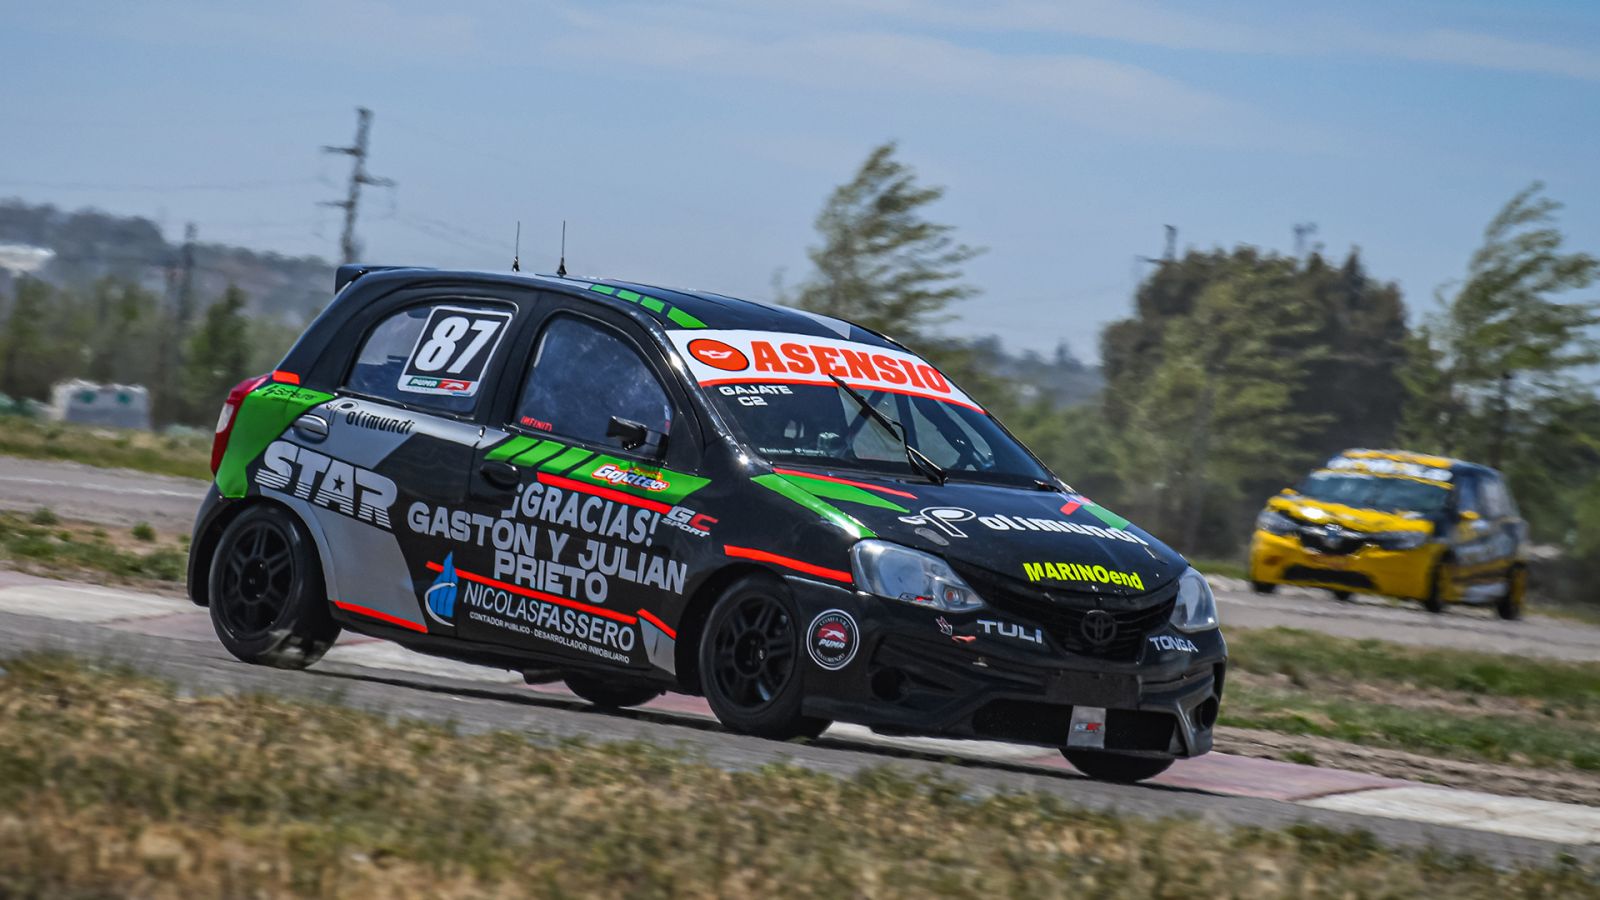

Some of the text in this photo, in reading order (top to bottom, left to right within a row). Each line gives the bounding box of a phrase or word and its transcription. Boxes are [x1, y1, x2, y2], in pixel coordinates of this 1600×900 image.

[415, 316, 501, 374] 87
[751, 341, 951, 394] ASENSIO
[719, 384, 794, 396] GAJATE
[738, 396, 768, 406] C2
[254, 440, 398, 529] STAR
[509, 482, 661, 547] ¡GRACIAS!
[661, 517, 710, 537] SPORT
[666, 505, 718, 531] GC
[493, 549, 608, 603] PRIETO
[548, 529, 570, 562] Y
[578, 539, 687, 595] JULIAN
[1023, 562, 1145, 591] MARINOend
[469, 611, 504, 629] CONTADOR
[534, 629, 588, 650] DESARROLLADOR
[588, 646, 630, 664] INMOBILIARIO
[976, 619, 1042, 644] TULI
[1149, 636, 1199, 652] TONGA
